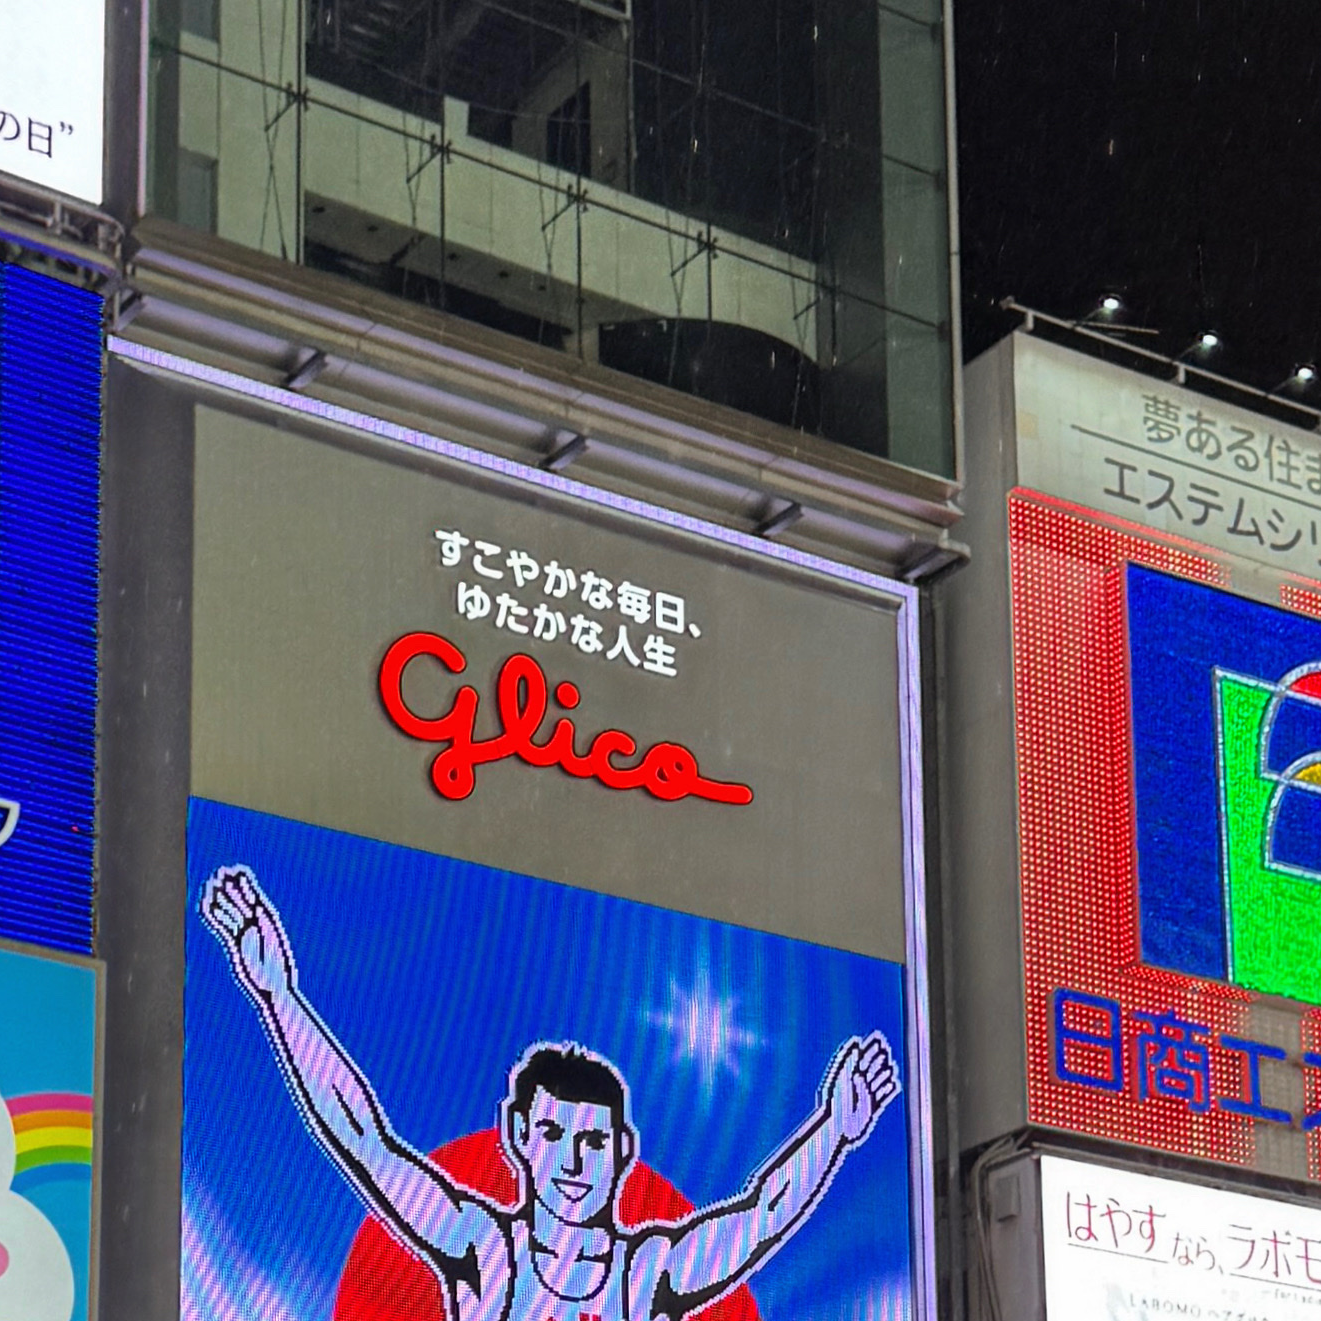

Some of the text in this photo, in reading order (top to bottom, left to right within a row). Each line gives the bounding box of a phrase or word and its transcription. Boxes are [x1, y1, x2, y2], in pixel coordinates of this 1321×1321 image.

[434, 529, 702, 639] すこやかな毎日、
[457, 582, 679, 678] ゆたかな人生
[378, 631, 754, 806] Glico
